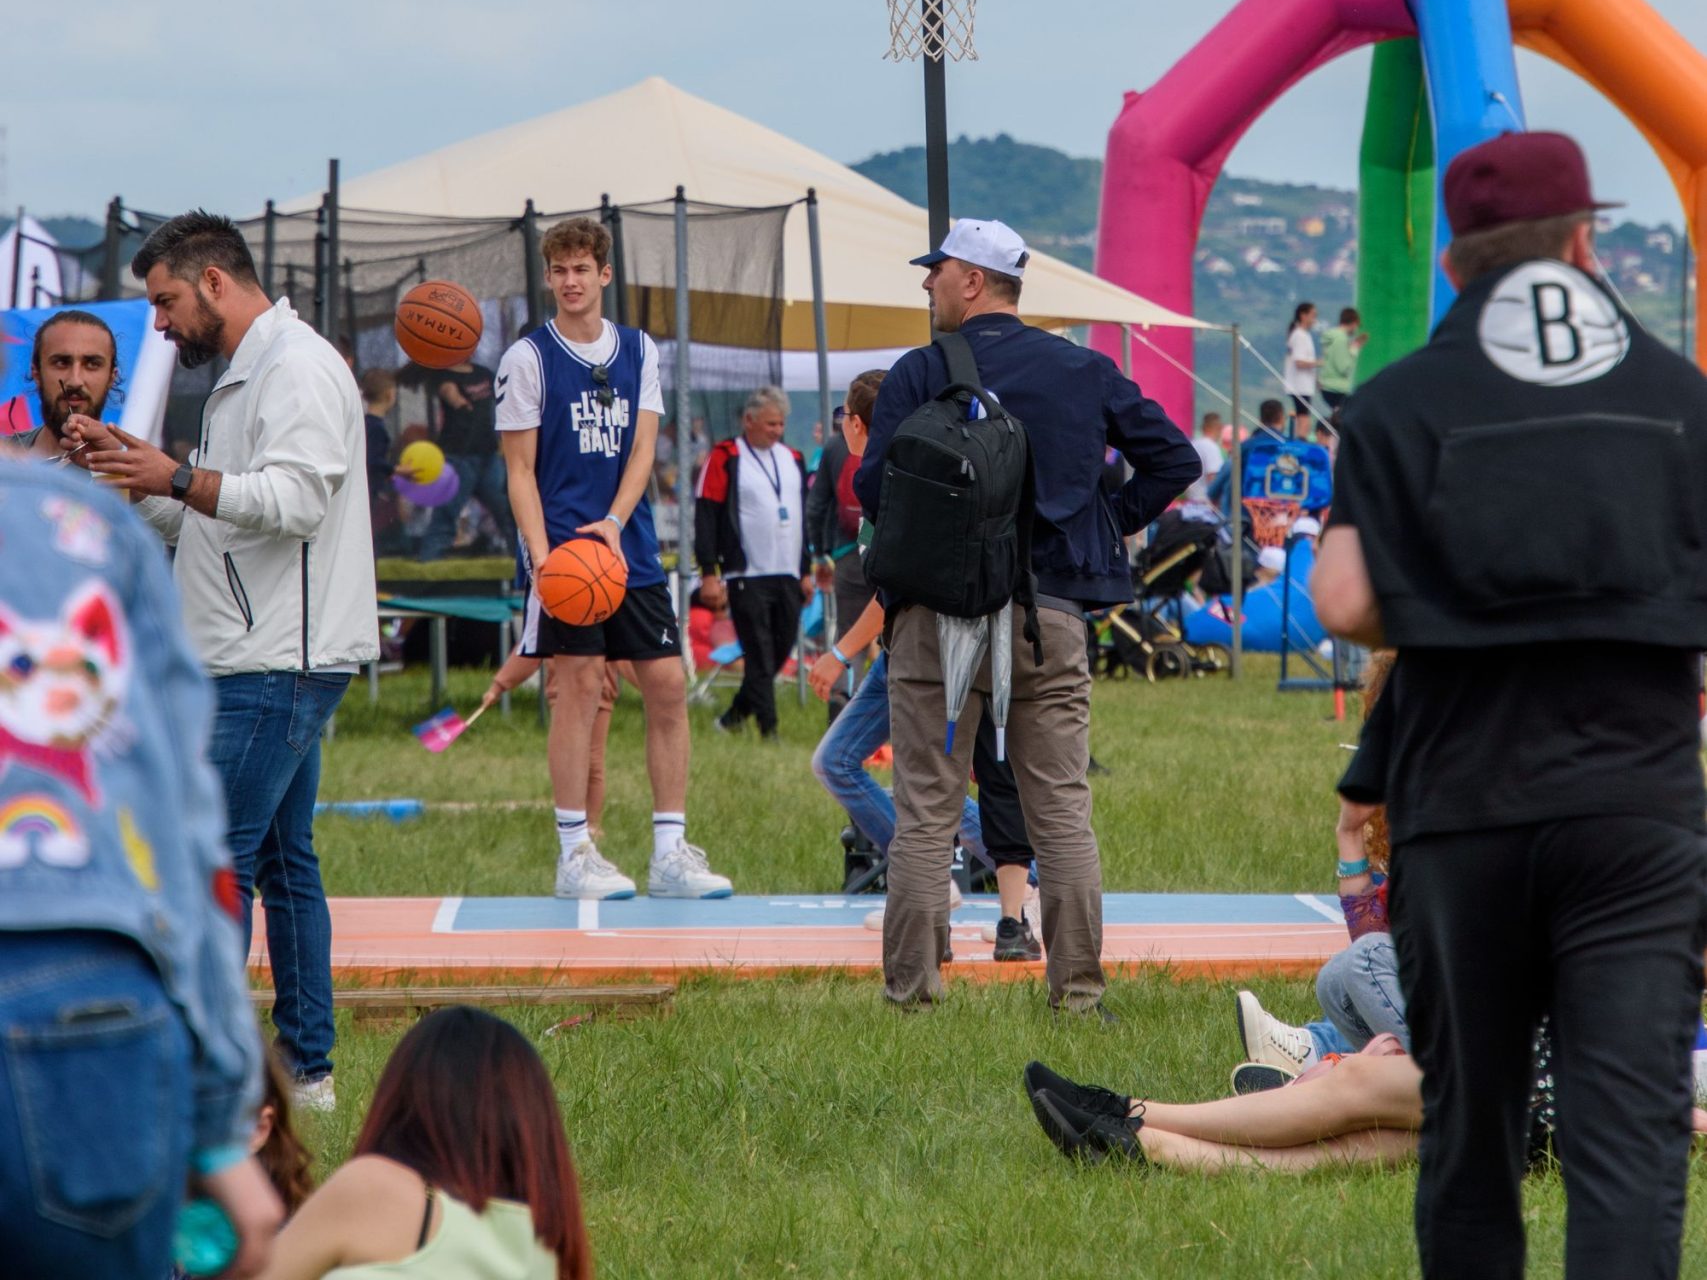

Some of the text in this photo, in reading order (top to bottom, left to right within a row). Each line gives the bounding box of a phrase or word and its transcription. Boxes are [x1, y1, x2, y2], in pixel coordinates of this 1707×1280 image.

[406, 310, 464, 341] TARMAK
[1531, 282, 1583, 367] B
[570, 391, 630, 432] FLYING
